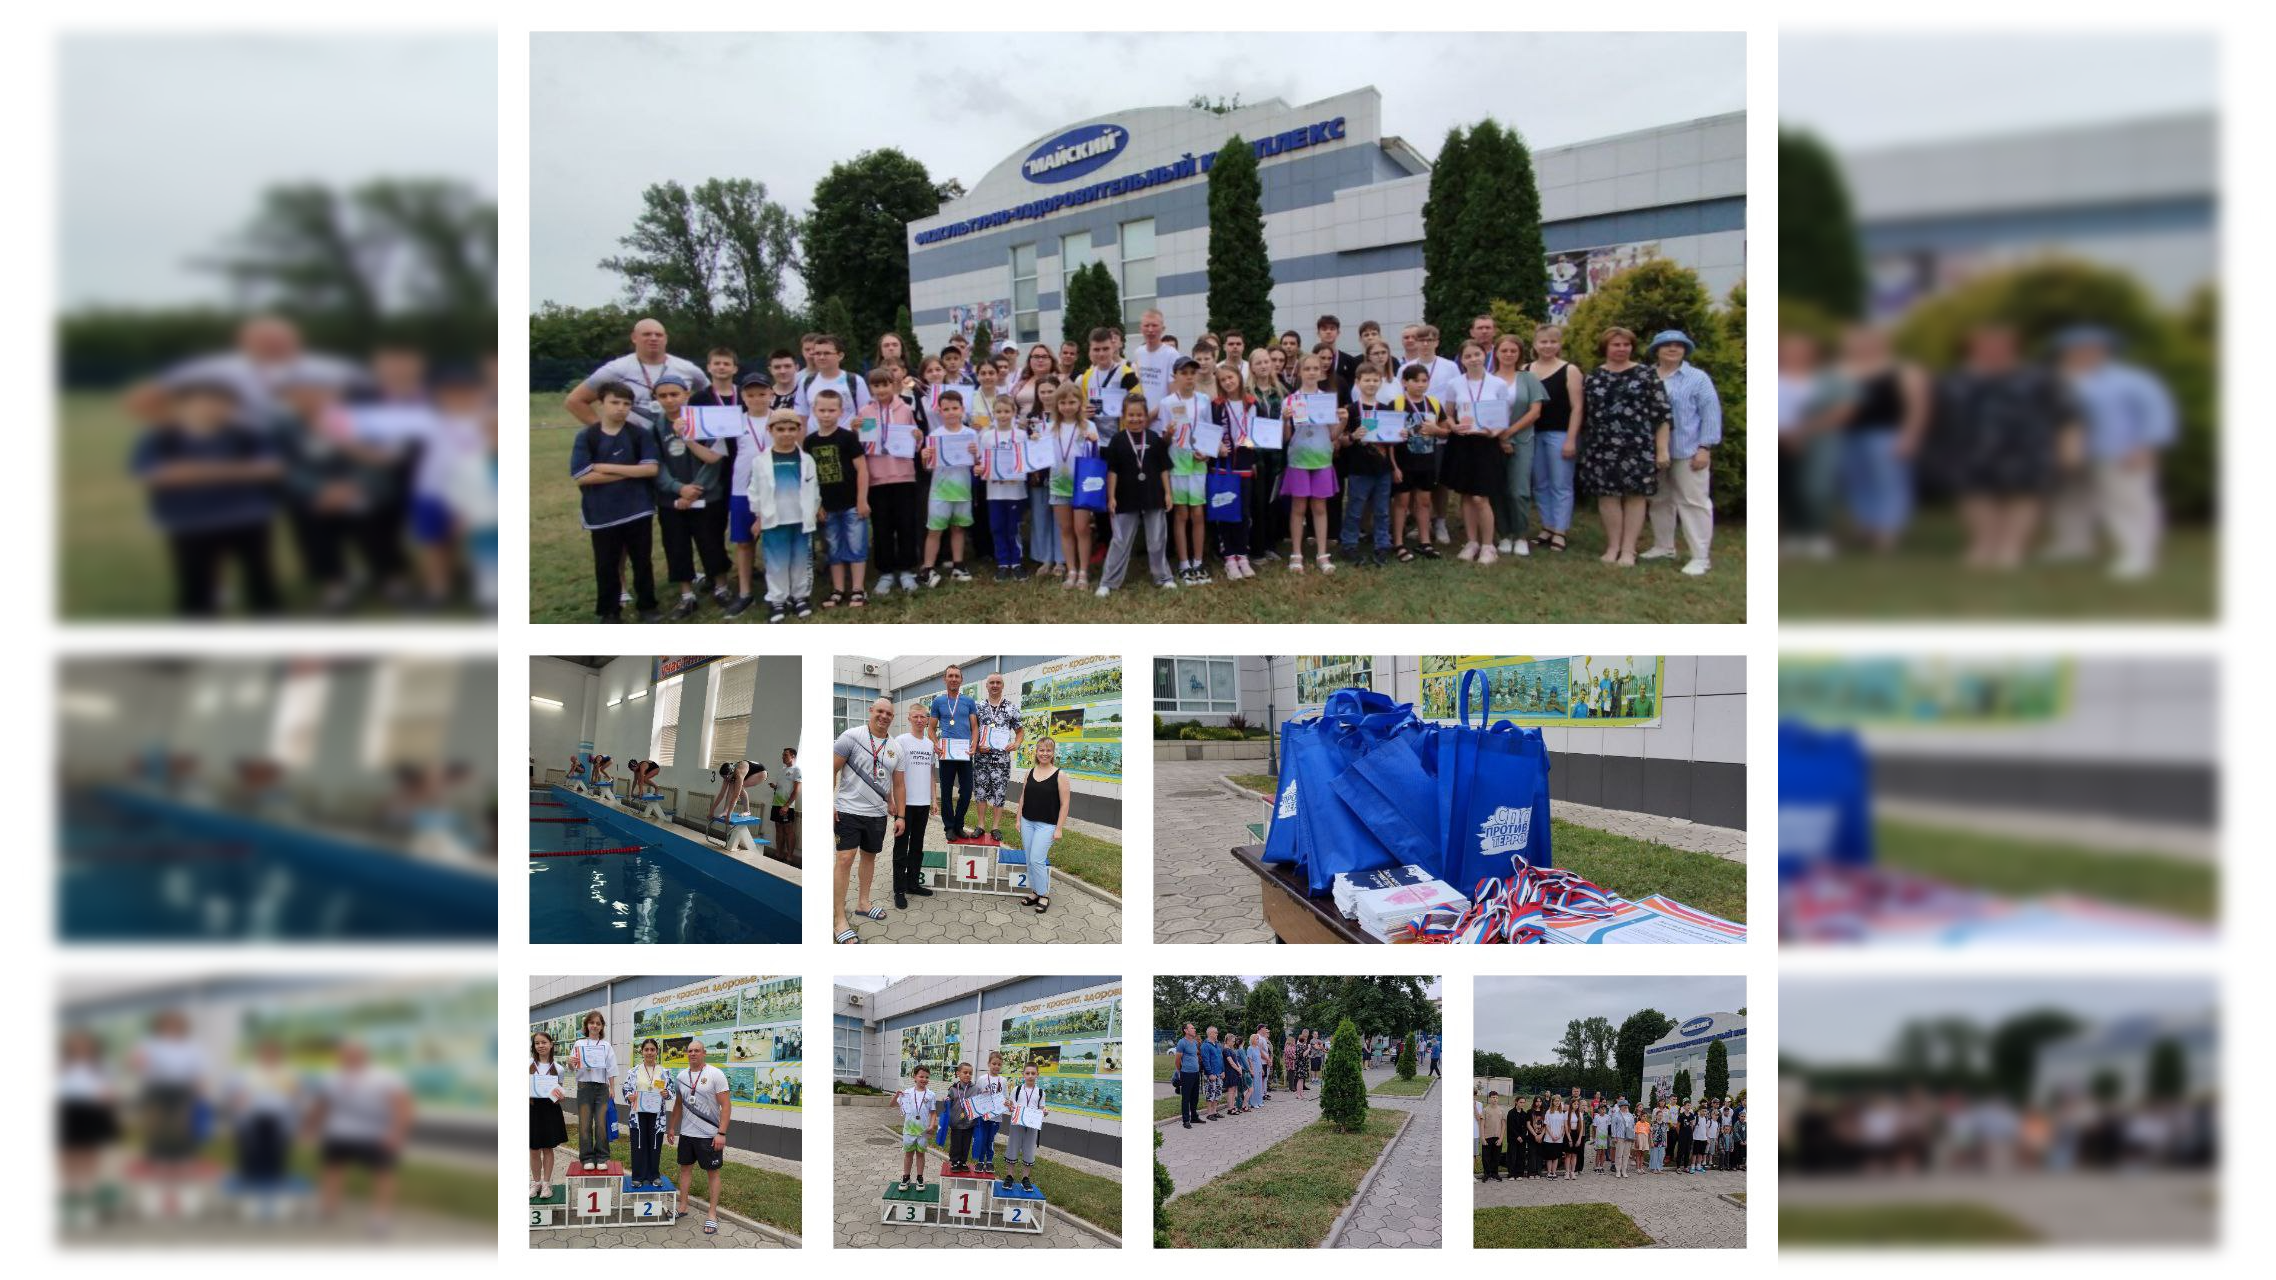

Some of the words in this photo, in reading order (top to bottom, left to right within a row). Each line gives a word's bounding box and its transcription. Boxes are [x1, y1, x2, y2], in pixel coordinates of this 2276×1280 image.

[1201, 116, 1346, 173] КПЛЕКС
[711, 770, 716, 783] 3
[1485, 822, 1529, 838] ПРОТИВ
[965, 860, 979, 880] 1
[1017, 874, 1028, 887] 2
[587, 1191, 601, 1213] 1
[643, 1201, 653, 1216] 2
[958, 1193, 972, 1214] 1
[531, 1210, 542, 1225] 3
[905, 1206, 916, 1221] 3
[1011, 1208, 1022, 1222] 2
